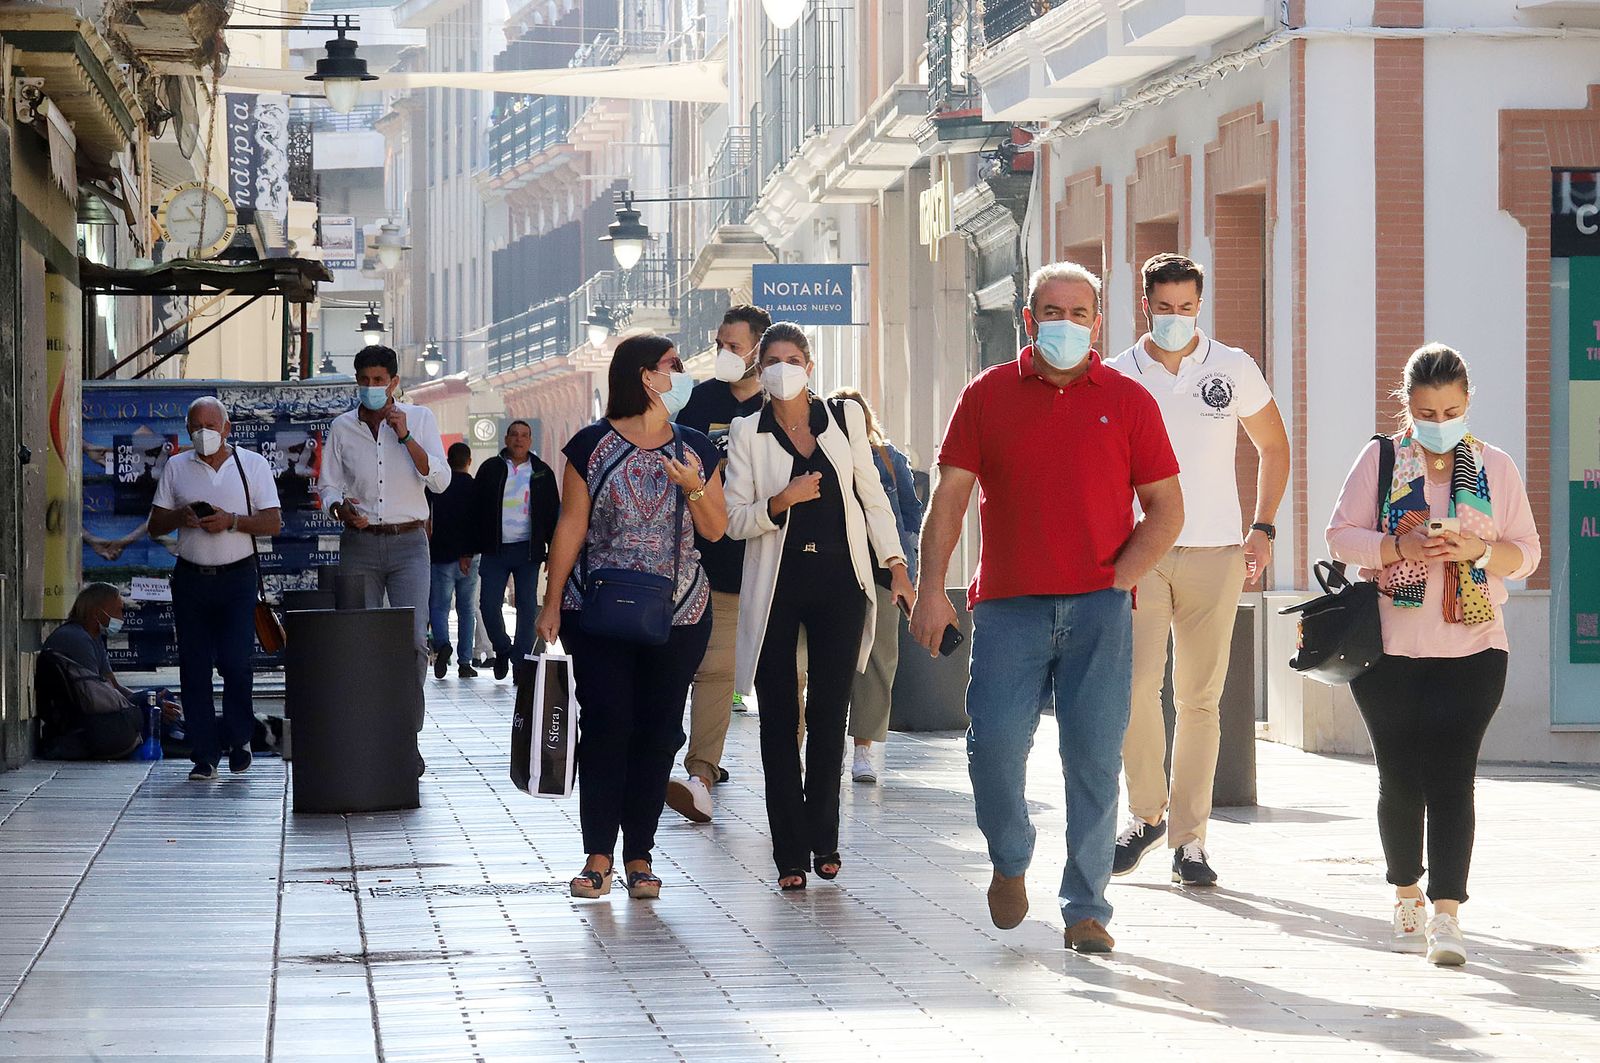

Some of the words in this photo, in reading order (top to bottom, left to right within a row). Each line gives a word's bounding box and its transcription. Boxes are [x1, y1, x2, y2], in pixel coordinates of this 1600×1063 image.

[762, 279, 844, 296] NOTARÍA
[776, 303, 808, 312] ABALOS
[811, 303, 842, 312] NUEVO
[235, 423, 270, 431] DIBUJO
[228, 430, 257, 439] ARTÍS
[118, 464, 132, 473] AD
[118, 472, 139, 483] WAY
